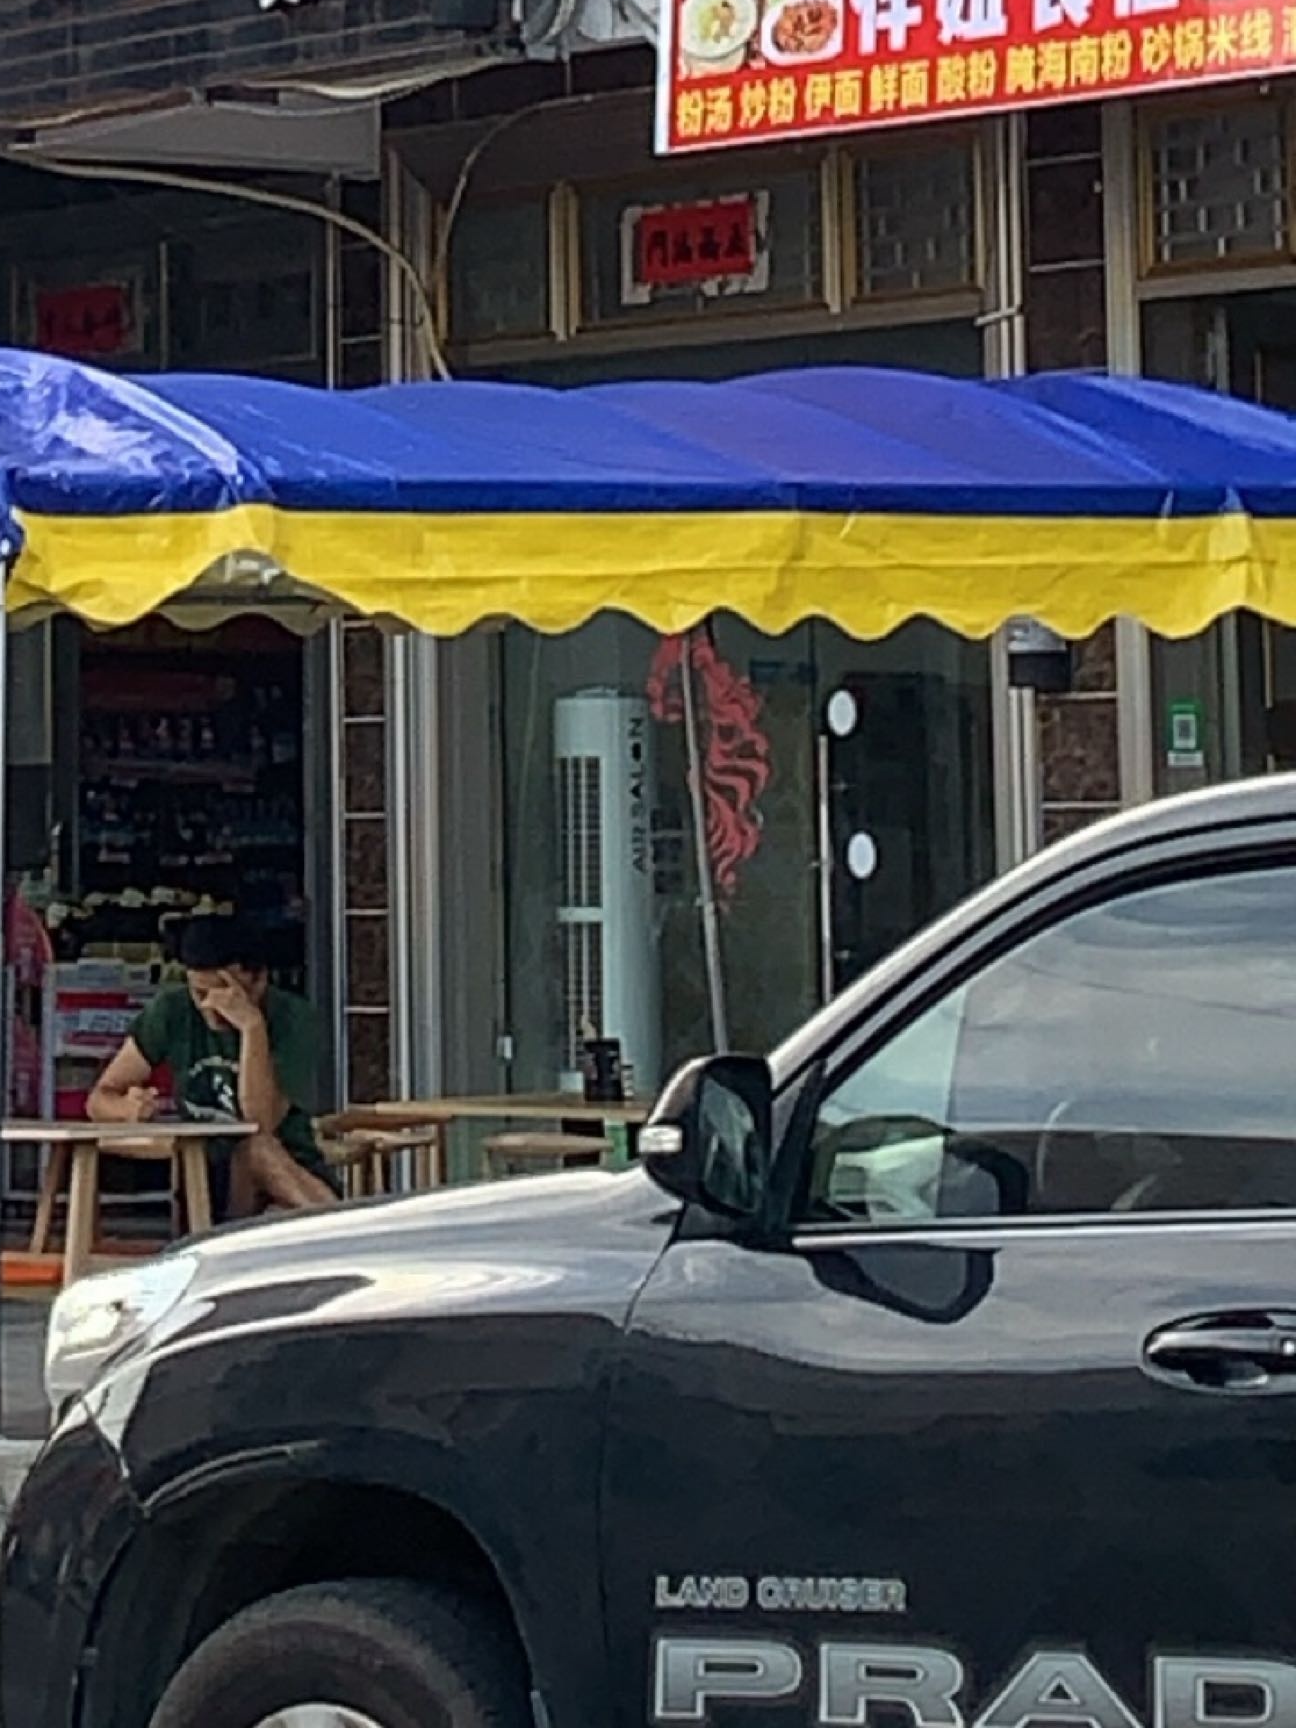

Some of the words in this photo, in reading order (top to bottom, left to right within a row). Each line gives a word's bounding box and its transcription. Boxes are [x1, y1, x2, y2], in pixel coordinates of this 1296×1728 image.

[805, 69, 865, 122] 伊面
[1140, 7, 1273, 75] 砂锅米线
[655, 1576, 750, 1609] LAND
[757, 1576, 907, 1612] CRUISER
[655, 1638, 1296, 1728] PRAD
